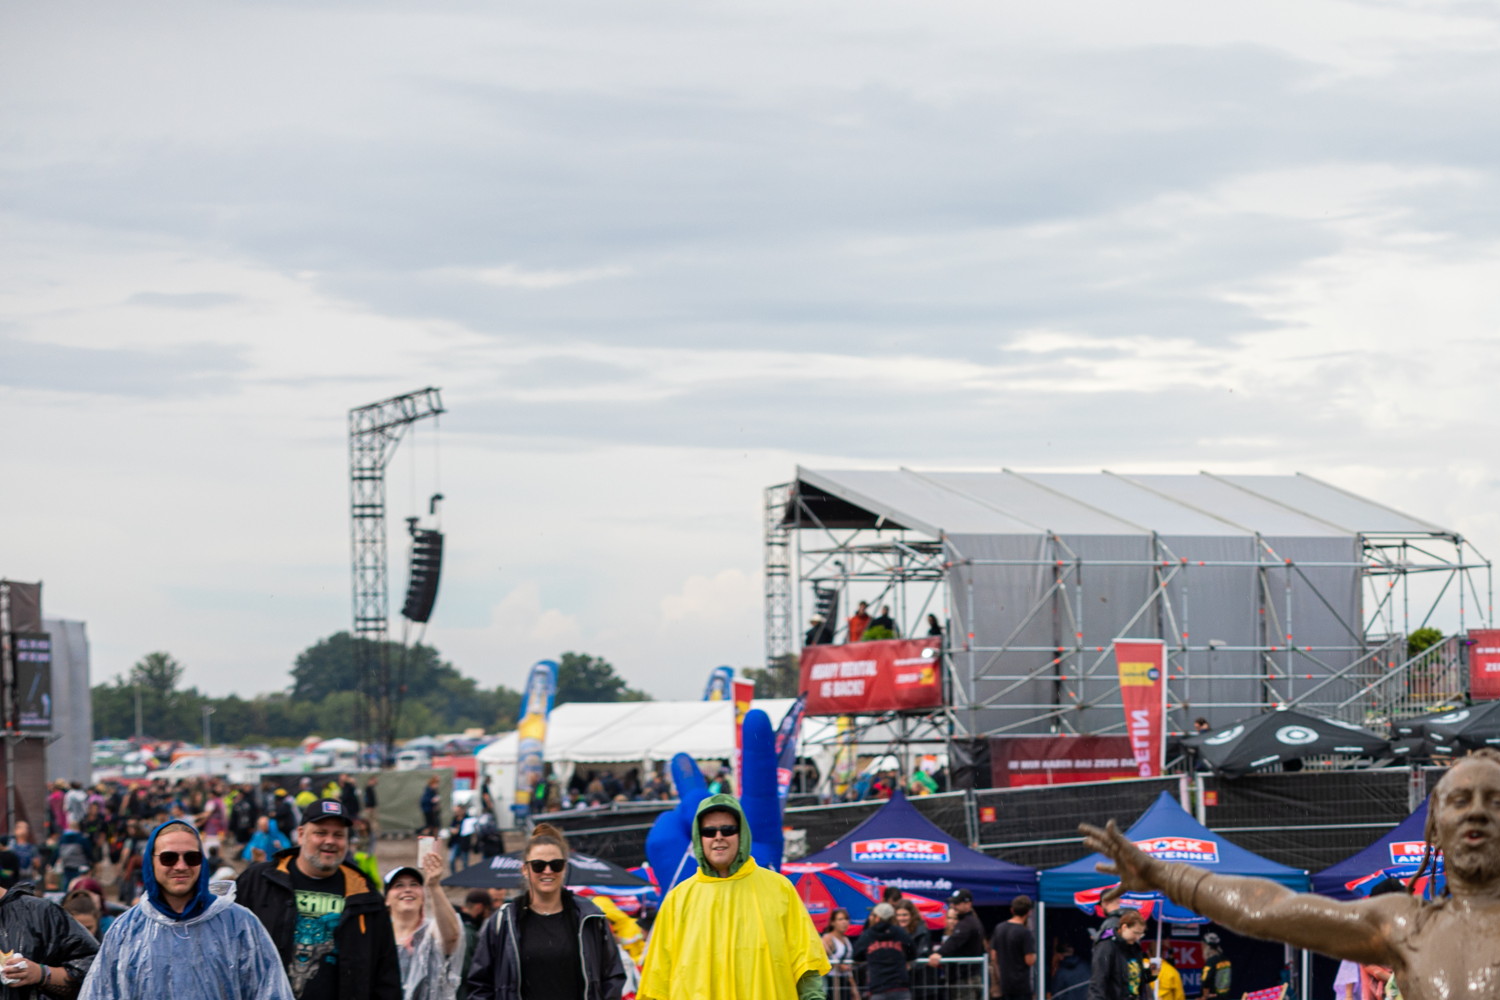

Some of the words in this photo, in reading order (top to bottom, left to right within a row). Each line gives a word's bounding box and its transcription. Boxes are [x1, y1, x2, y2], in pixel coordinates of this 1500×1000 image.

[866, 841, 934, 853] ROCK
[858, 852, 947, 861] ANTENNE
[874, 877, 953, 891] antenne.de
